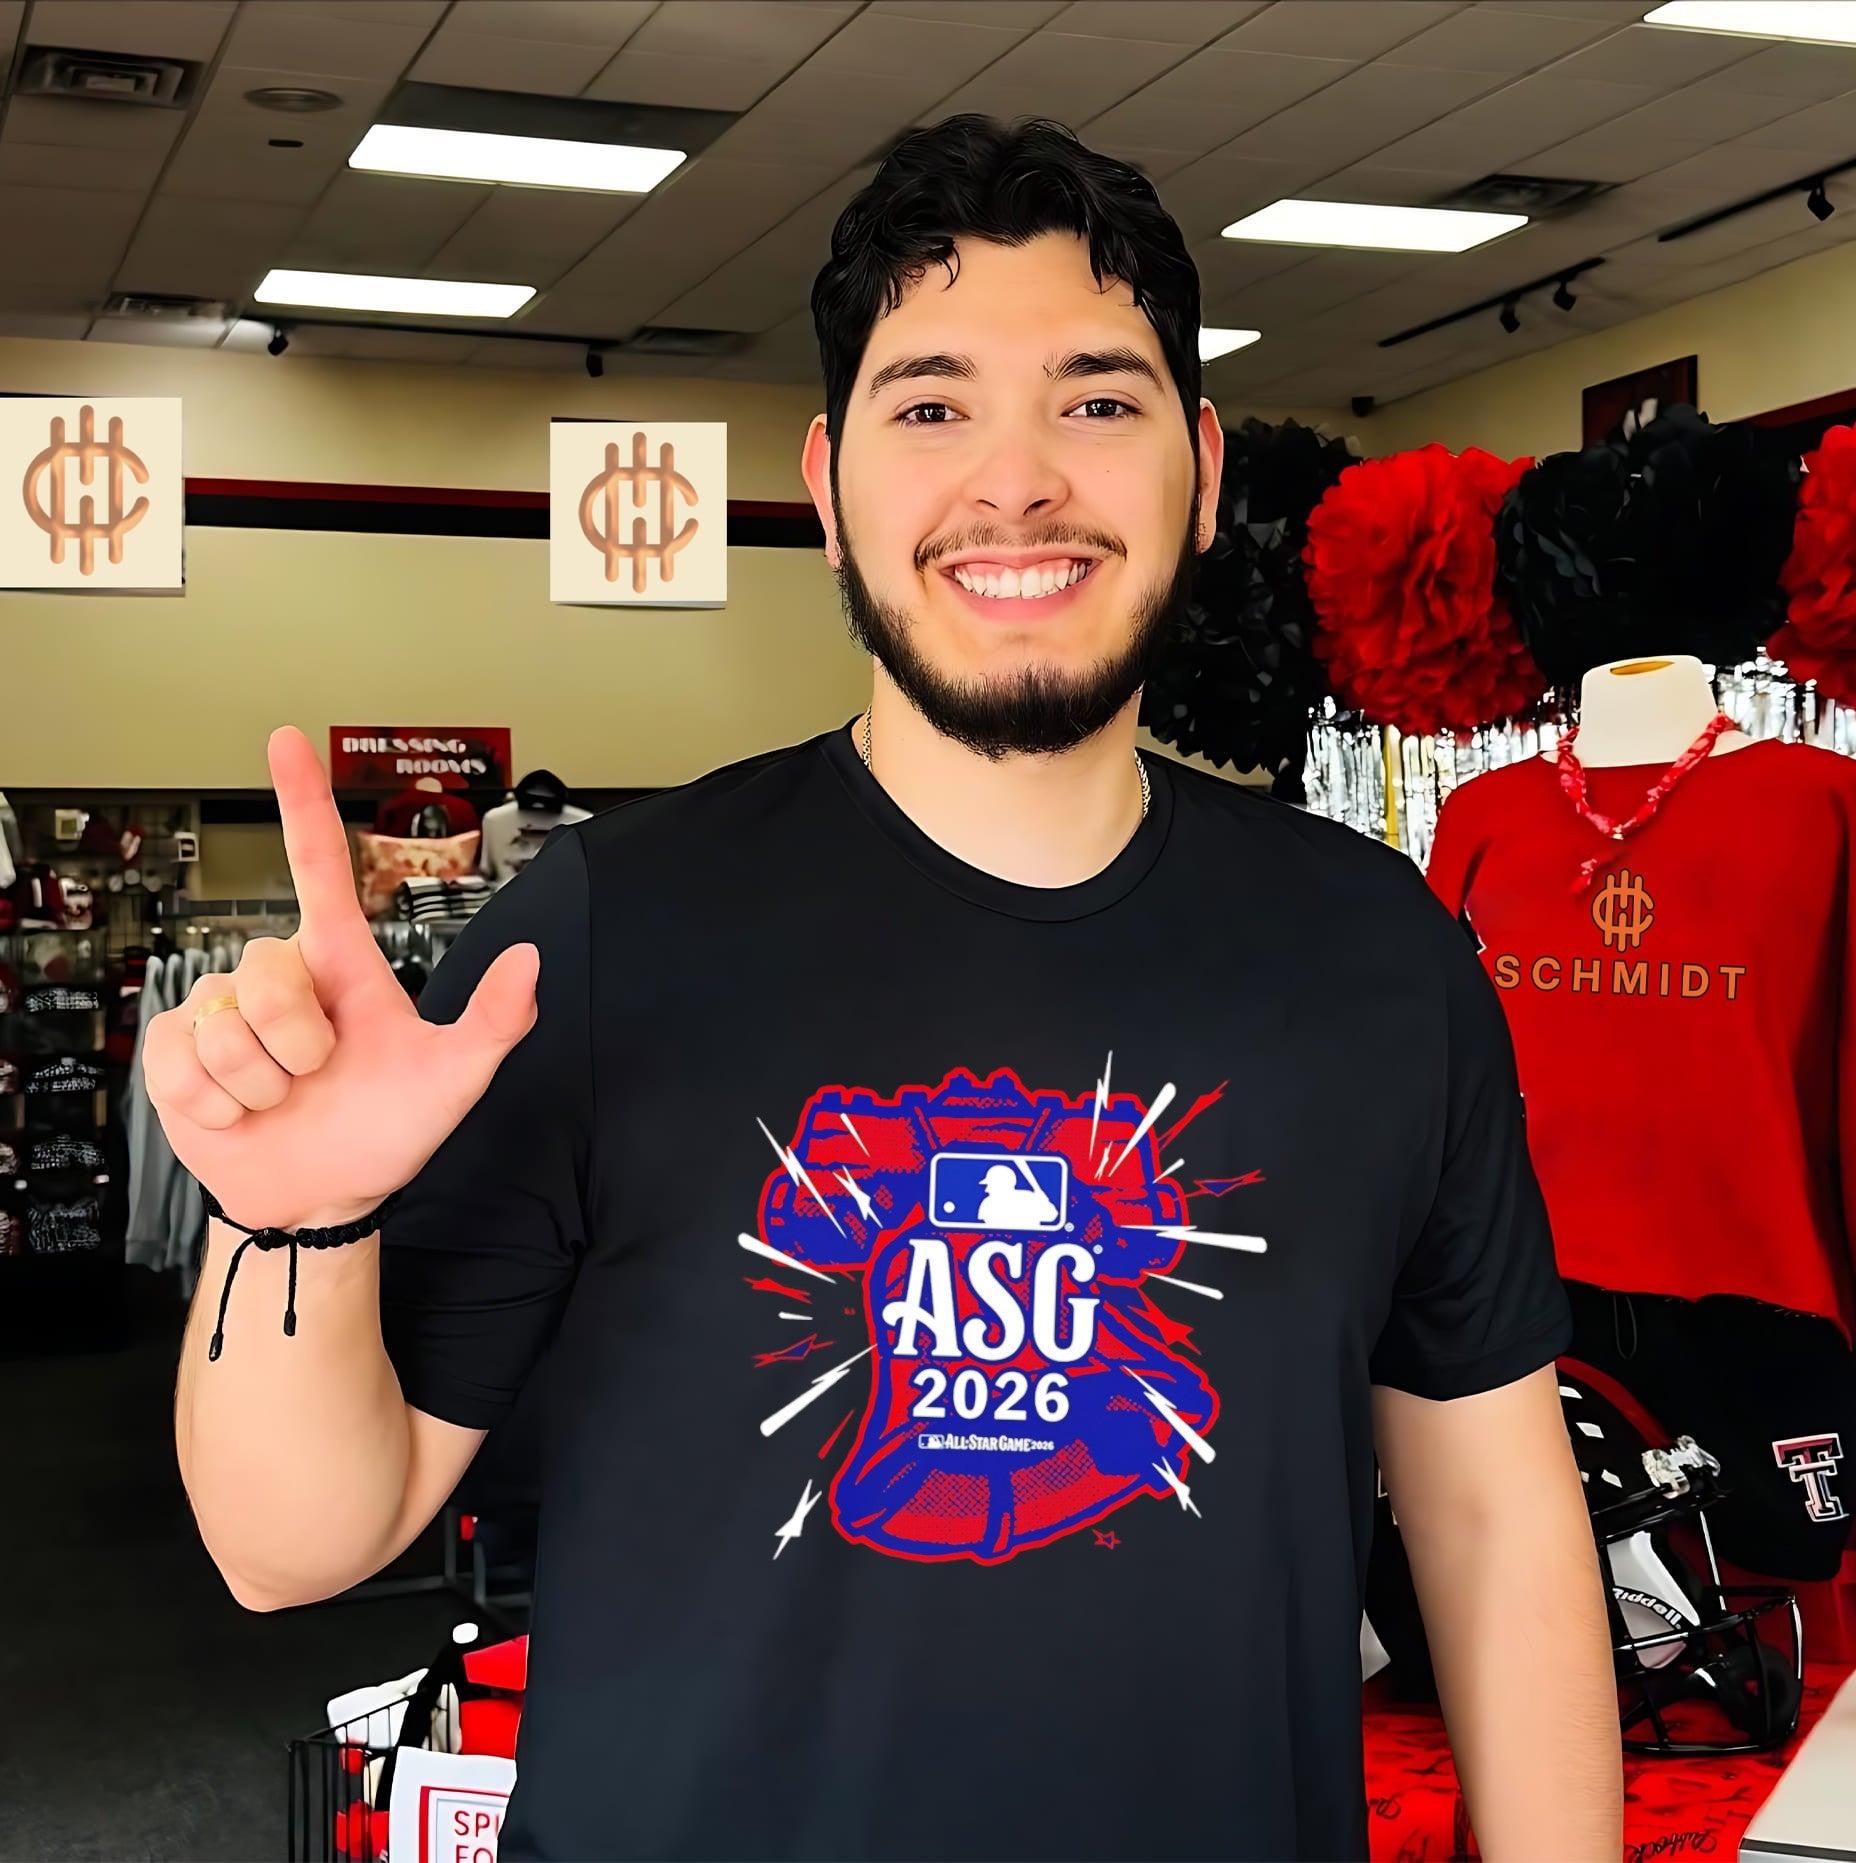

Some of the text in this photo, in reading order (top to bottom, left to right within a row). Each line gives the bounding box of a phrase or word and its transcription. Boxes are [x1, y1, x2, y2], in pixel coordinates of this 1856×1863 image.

[342, 737, 466, 753] DRESSING
[396, 758, 487, 774] ROOMS
[1494, 954, 1747, 1000] SCHMIDT
[882, 1238, 1100, 1363] ASG
[912, 1369, 1070, 1421] 2026
